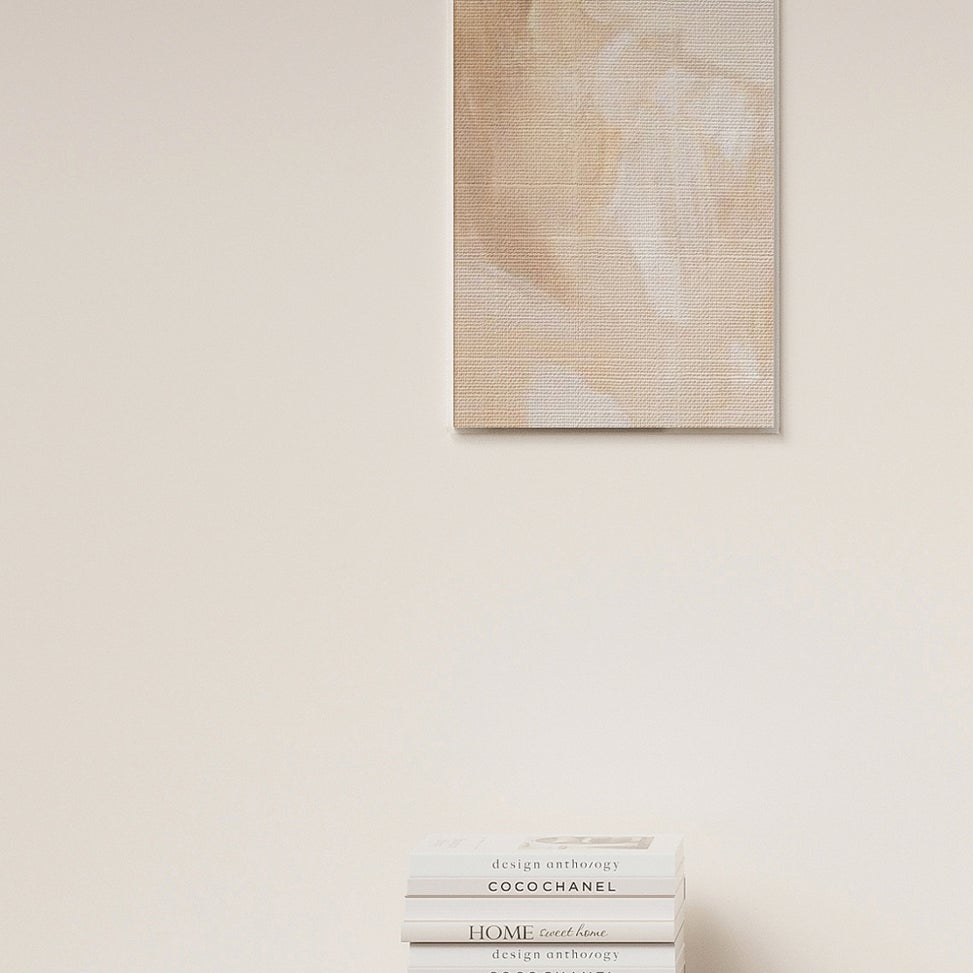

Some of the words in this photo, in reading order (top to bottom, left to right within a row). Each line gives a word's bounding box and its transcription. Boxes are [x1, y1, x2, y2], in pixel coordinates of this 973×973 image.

[491, 858, 541, 871] design
[546, 858, 620, 871] anthology
[469, 925, 535, 941] HOME
[539, 928, 574, 938] sweet
[575, 923, 609, 938] home
[491, 949, 541, 962] design
[546, 949, 620, 962] anthology
